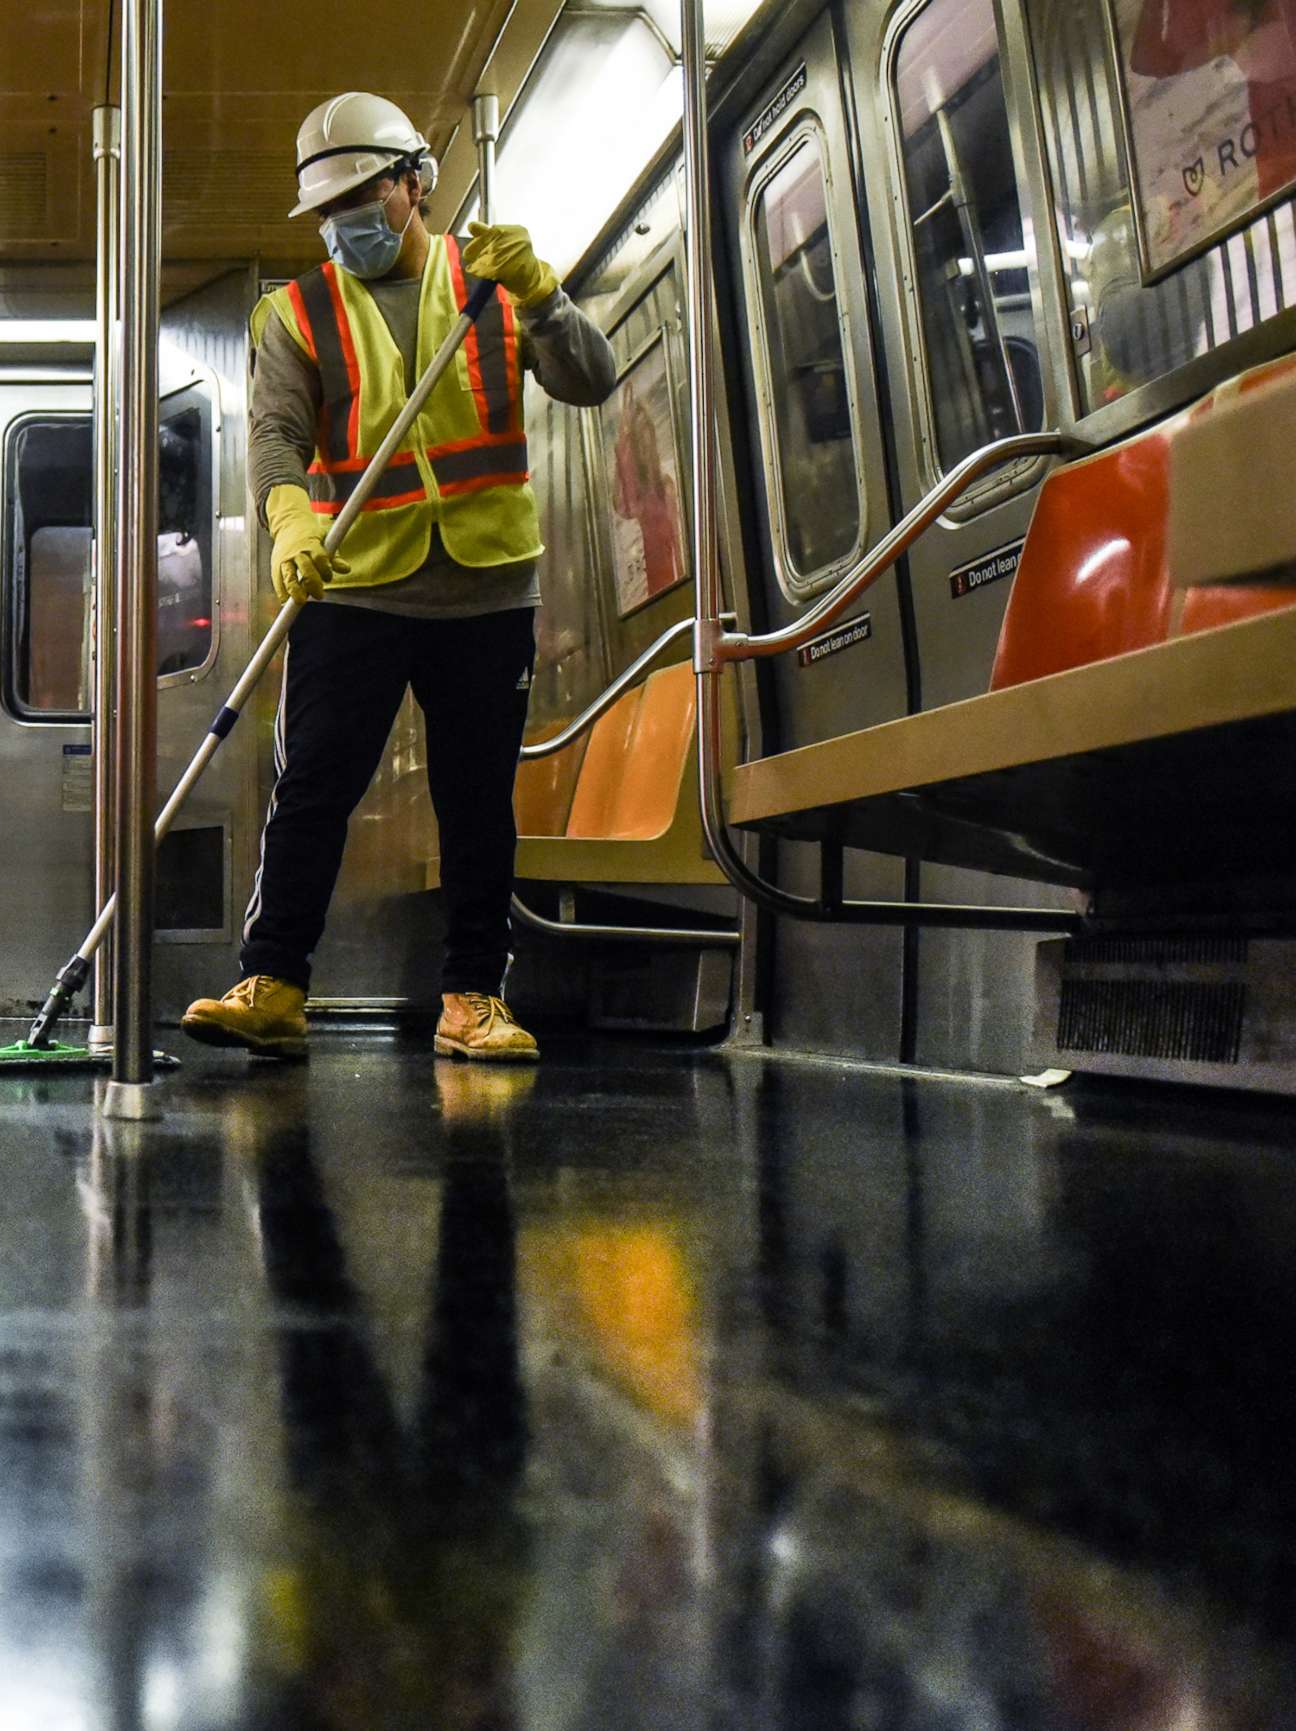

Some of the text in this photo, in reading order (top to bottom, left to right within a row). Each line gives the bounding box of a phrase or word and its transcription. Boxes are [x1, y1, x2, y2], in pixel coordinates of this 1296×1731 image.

[762, 111, 772, 129] not
[772, 94, 786, 117] hold
[786, 74, 805, 102] doors
[969, 571, 981, 586] Do
[981, 561, 997, 581] not
[996, 554, 1017, 574] lean
[811, 625, 868, 659] Do not lean on door
